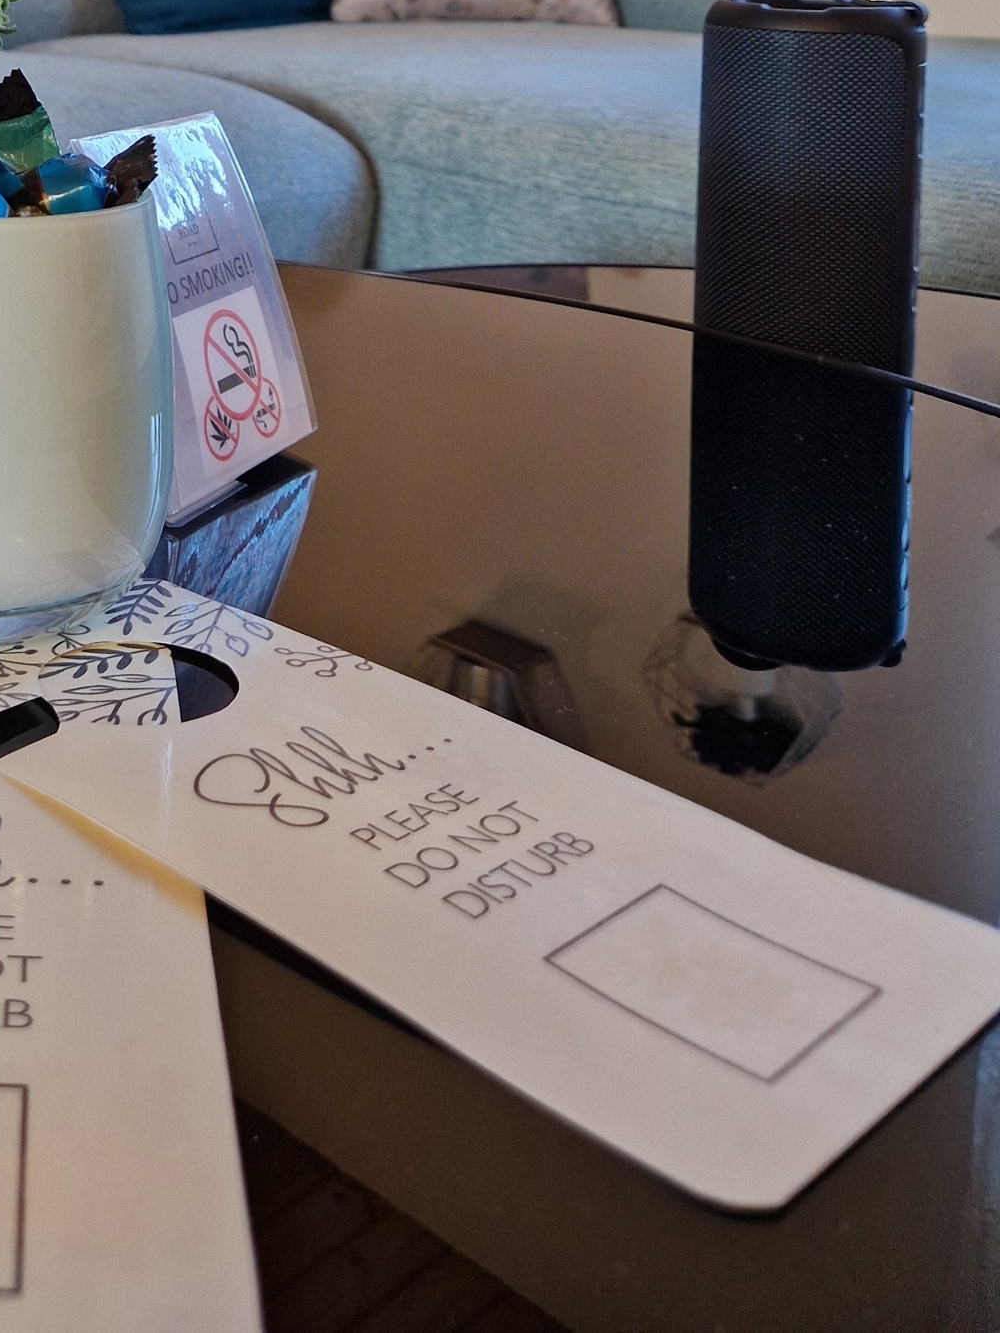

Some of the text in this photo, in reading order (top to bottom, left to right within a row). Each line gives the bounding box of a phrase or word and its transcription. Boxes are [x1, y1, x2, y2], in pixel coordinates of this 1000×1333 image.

[166, 251, 255, 304] O SMOKING!!
[349, 782, 480, 851] PLEASE
[383, 799, 540, 889] DO NOT
[441, 831, 596, 920] DISTURB
